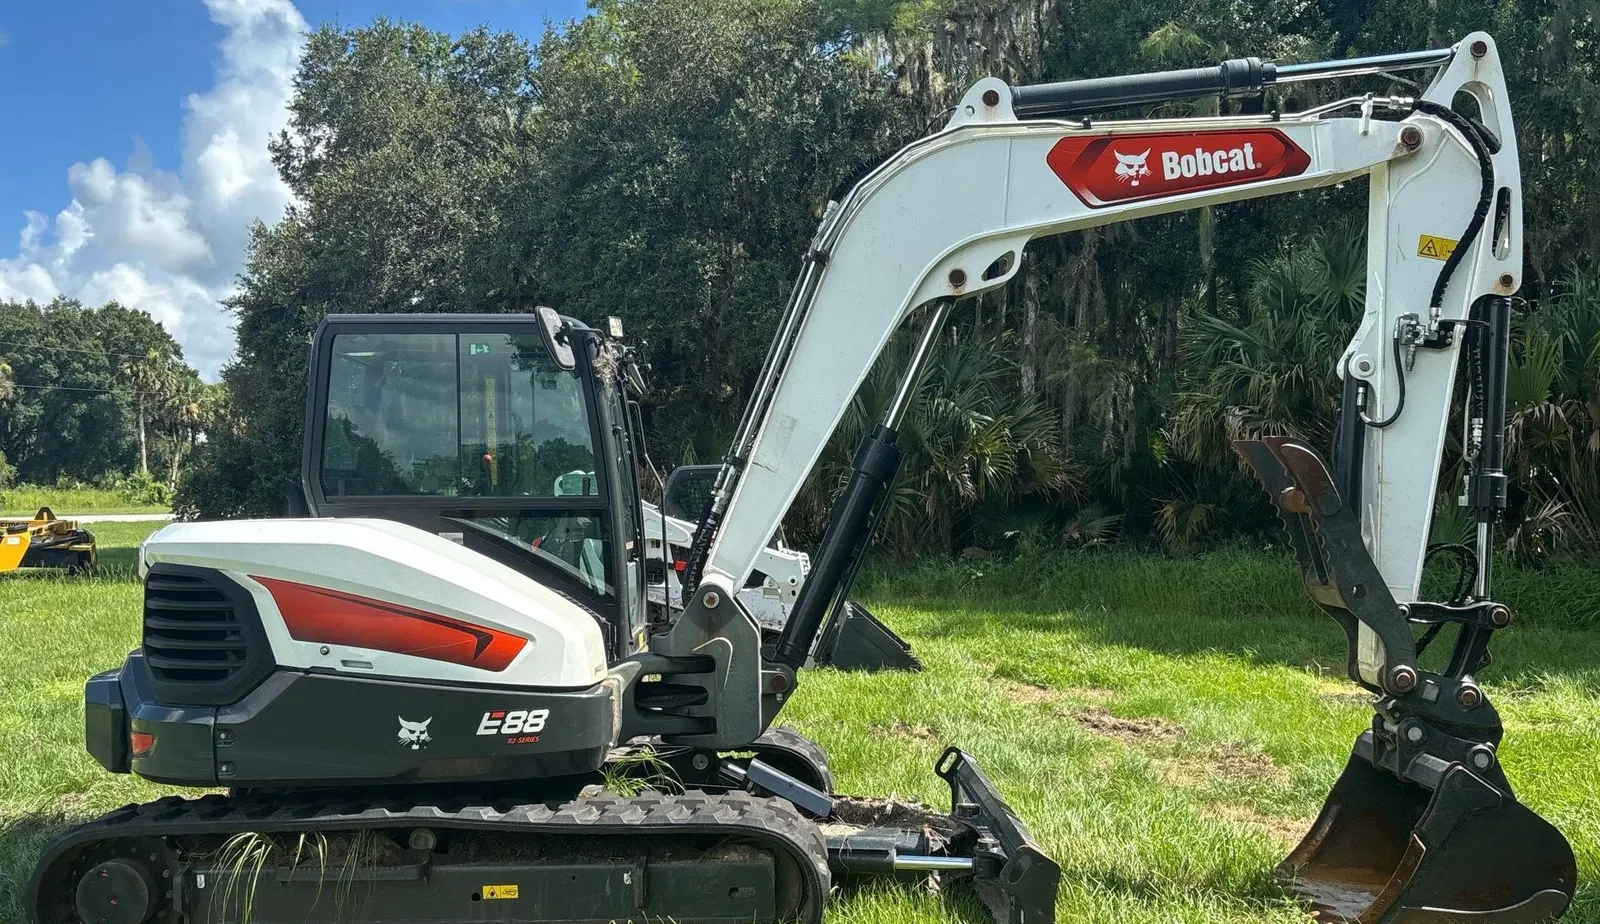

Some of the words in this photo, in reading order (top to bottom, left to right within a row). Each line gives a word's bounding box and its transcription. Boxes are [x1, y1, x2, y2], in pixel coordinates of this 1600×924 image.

[1162, 143, 1255, 180] Bobcat
[476, 709, 550, 735] E88
[507, 736, 540, 744] R2-SERIES
